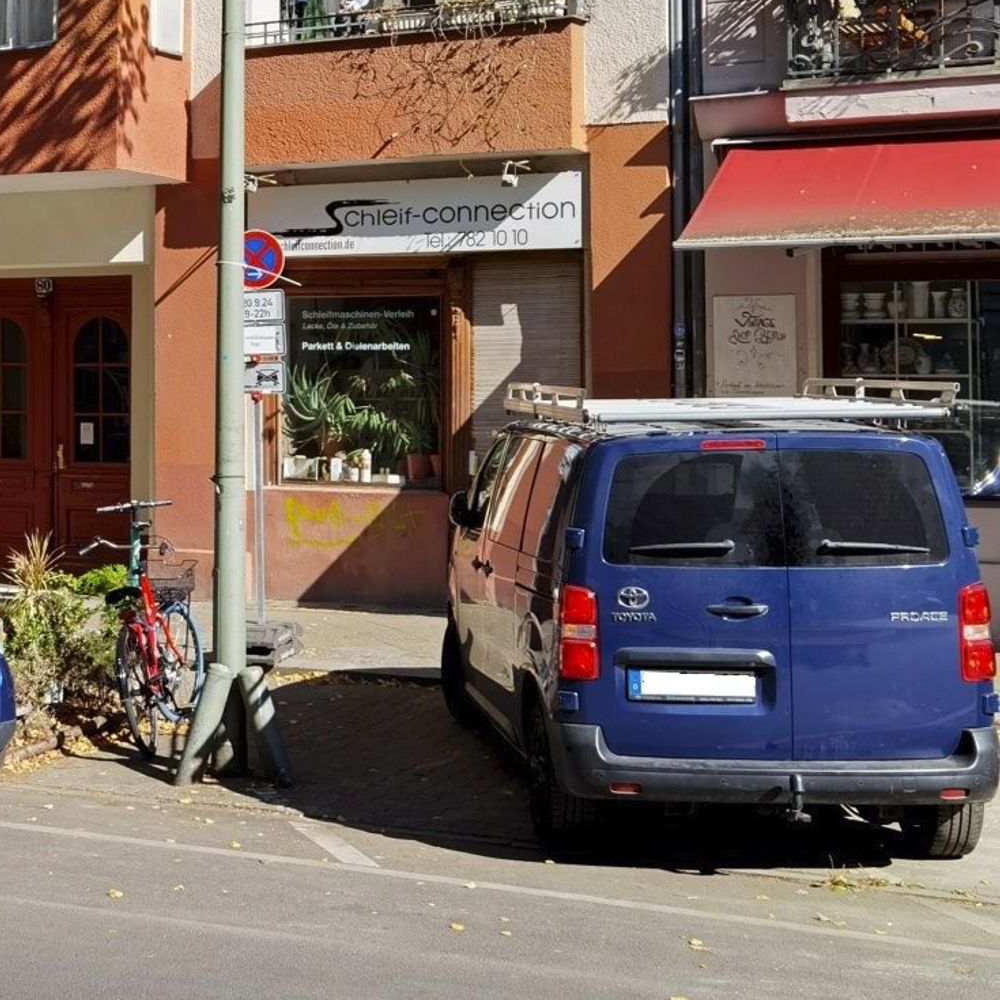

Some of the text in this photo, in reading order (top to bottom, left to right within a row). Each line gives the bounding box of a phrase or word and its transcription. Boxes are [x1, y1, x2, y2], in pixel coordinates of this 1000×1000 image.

[270, 198, 576, 237] Schleif-connection
[457, 230, 486, 247] 782
[491, 230, 507, 246] 10
[512, 228, 528, 245] 10
[301, 341, 334, 350] Parkett
[336, 341, 342, 350] &
[611, 612, 657, 622] TOYOTA
[890, 611, 949, 622] PROACE
